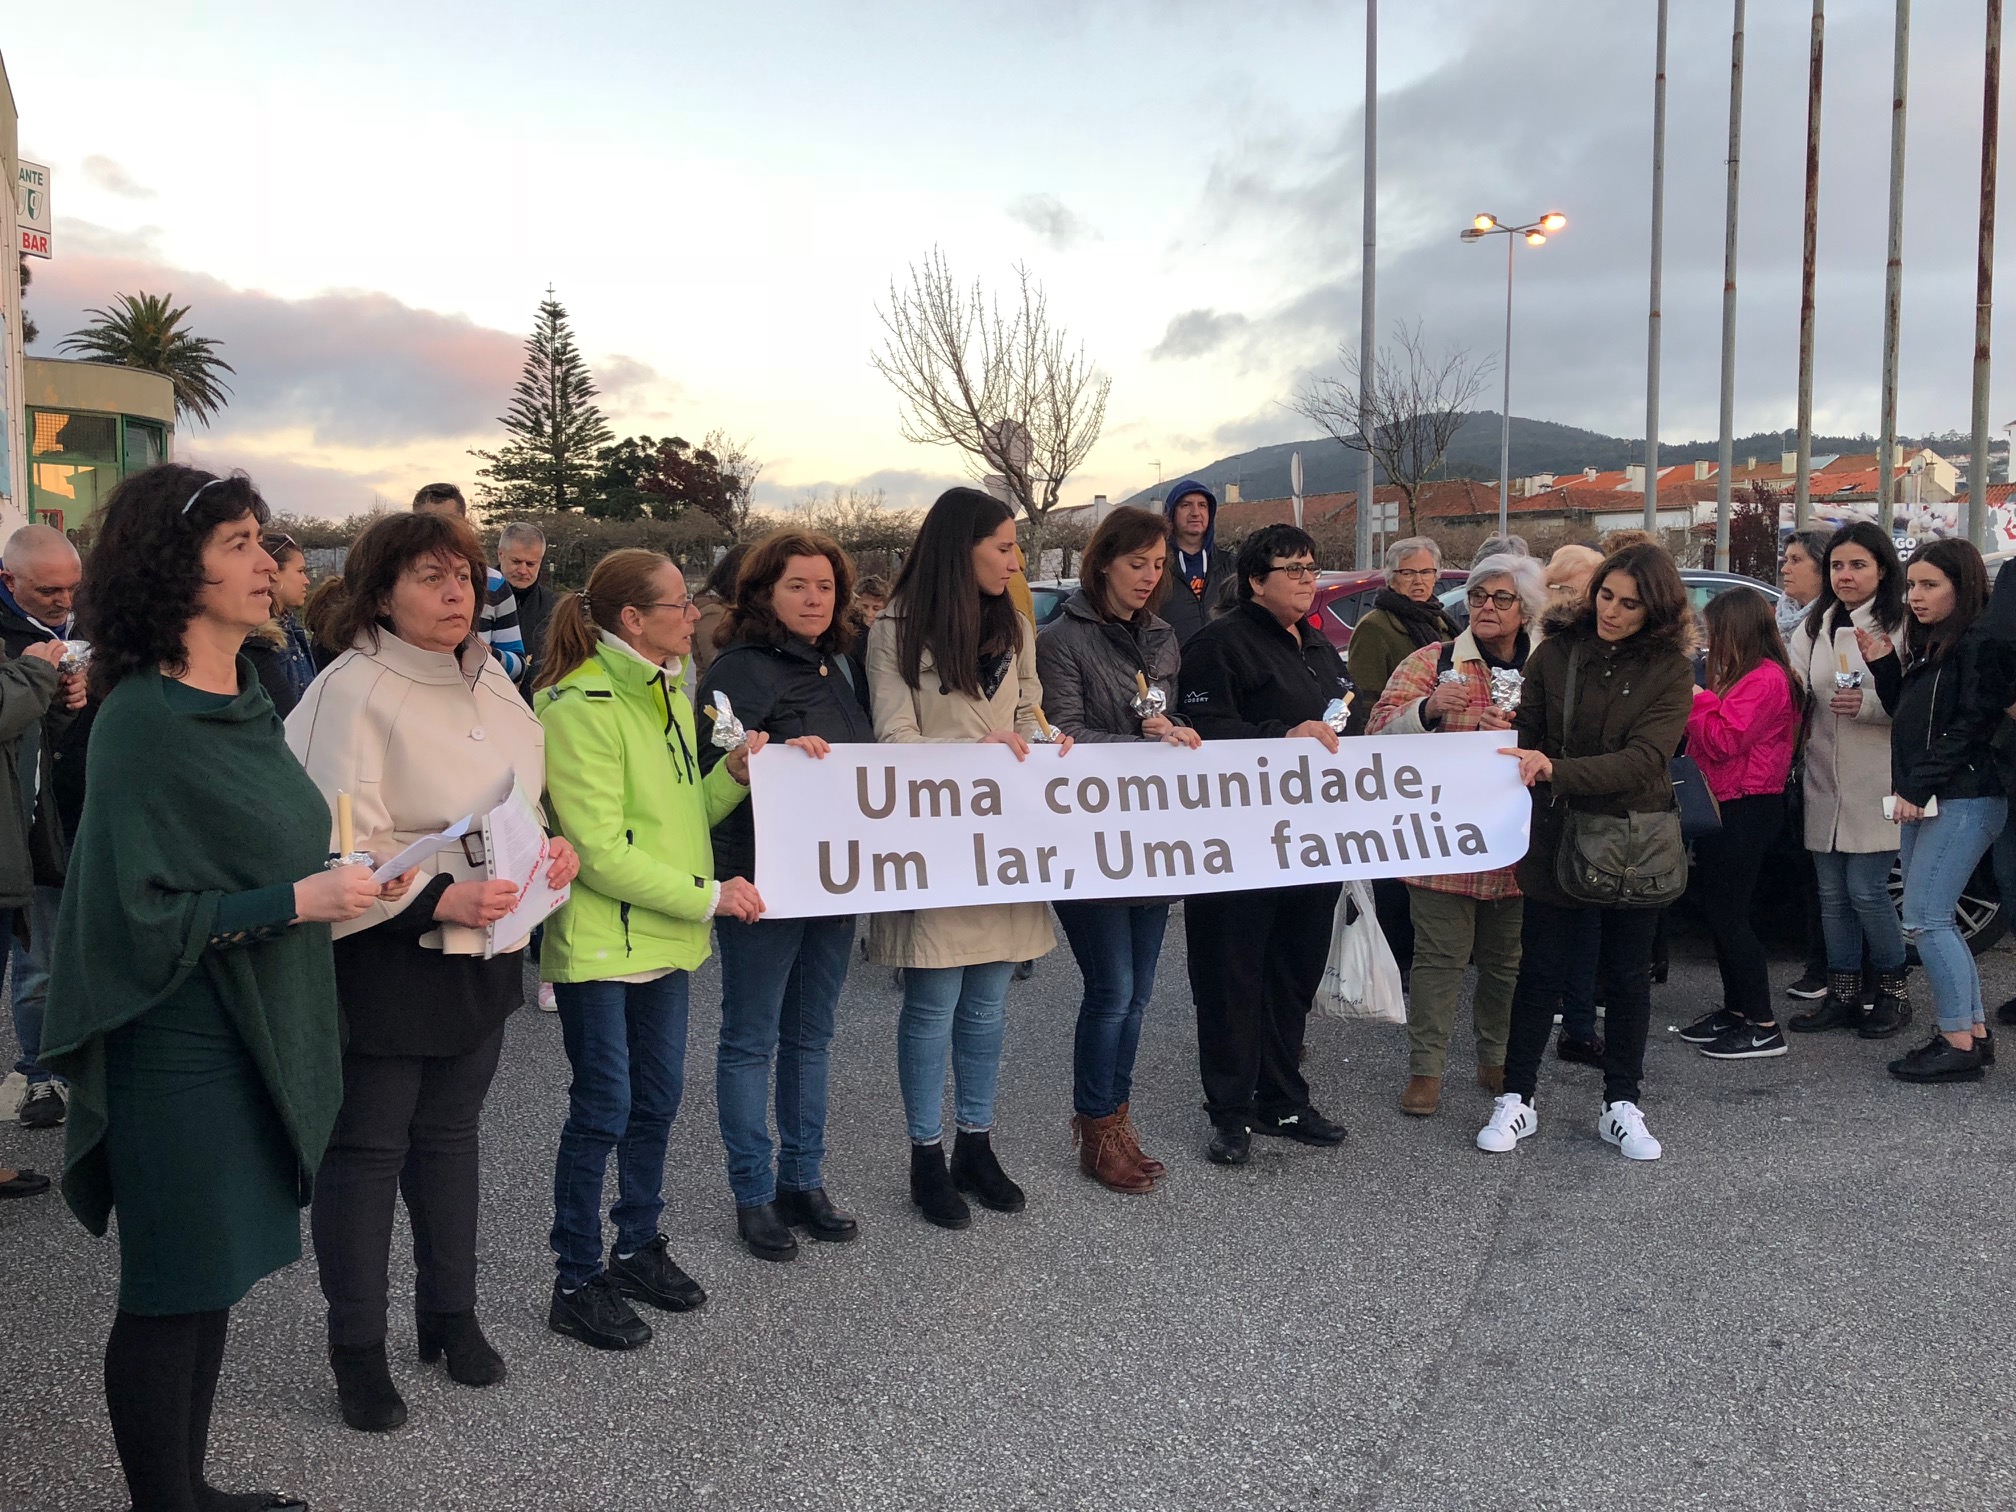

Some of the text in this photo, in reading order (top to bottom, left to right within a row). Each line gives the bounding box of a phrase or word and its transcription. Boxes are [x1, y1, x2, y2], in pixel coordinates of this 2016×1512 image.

[22, 232, 48, 254] BAR
[855, 752, 1442, 820] Uma comunidade,
[817, 811, 1489, 895] Um lar, Uma família
